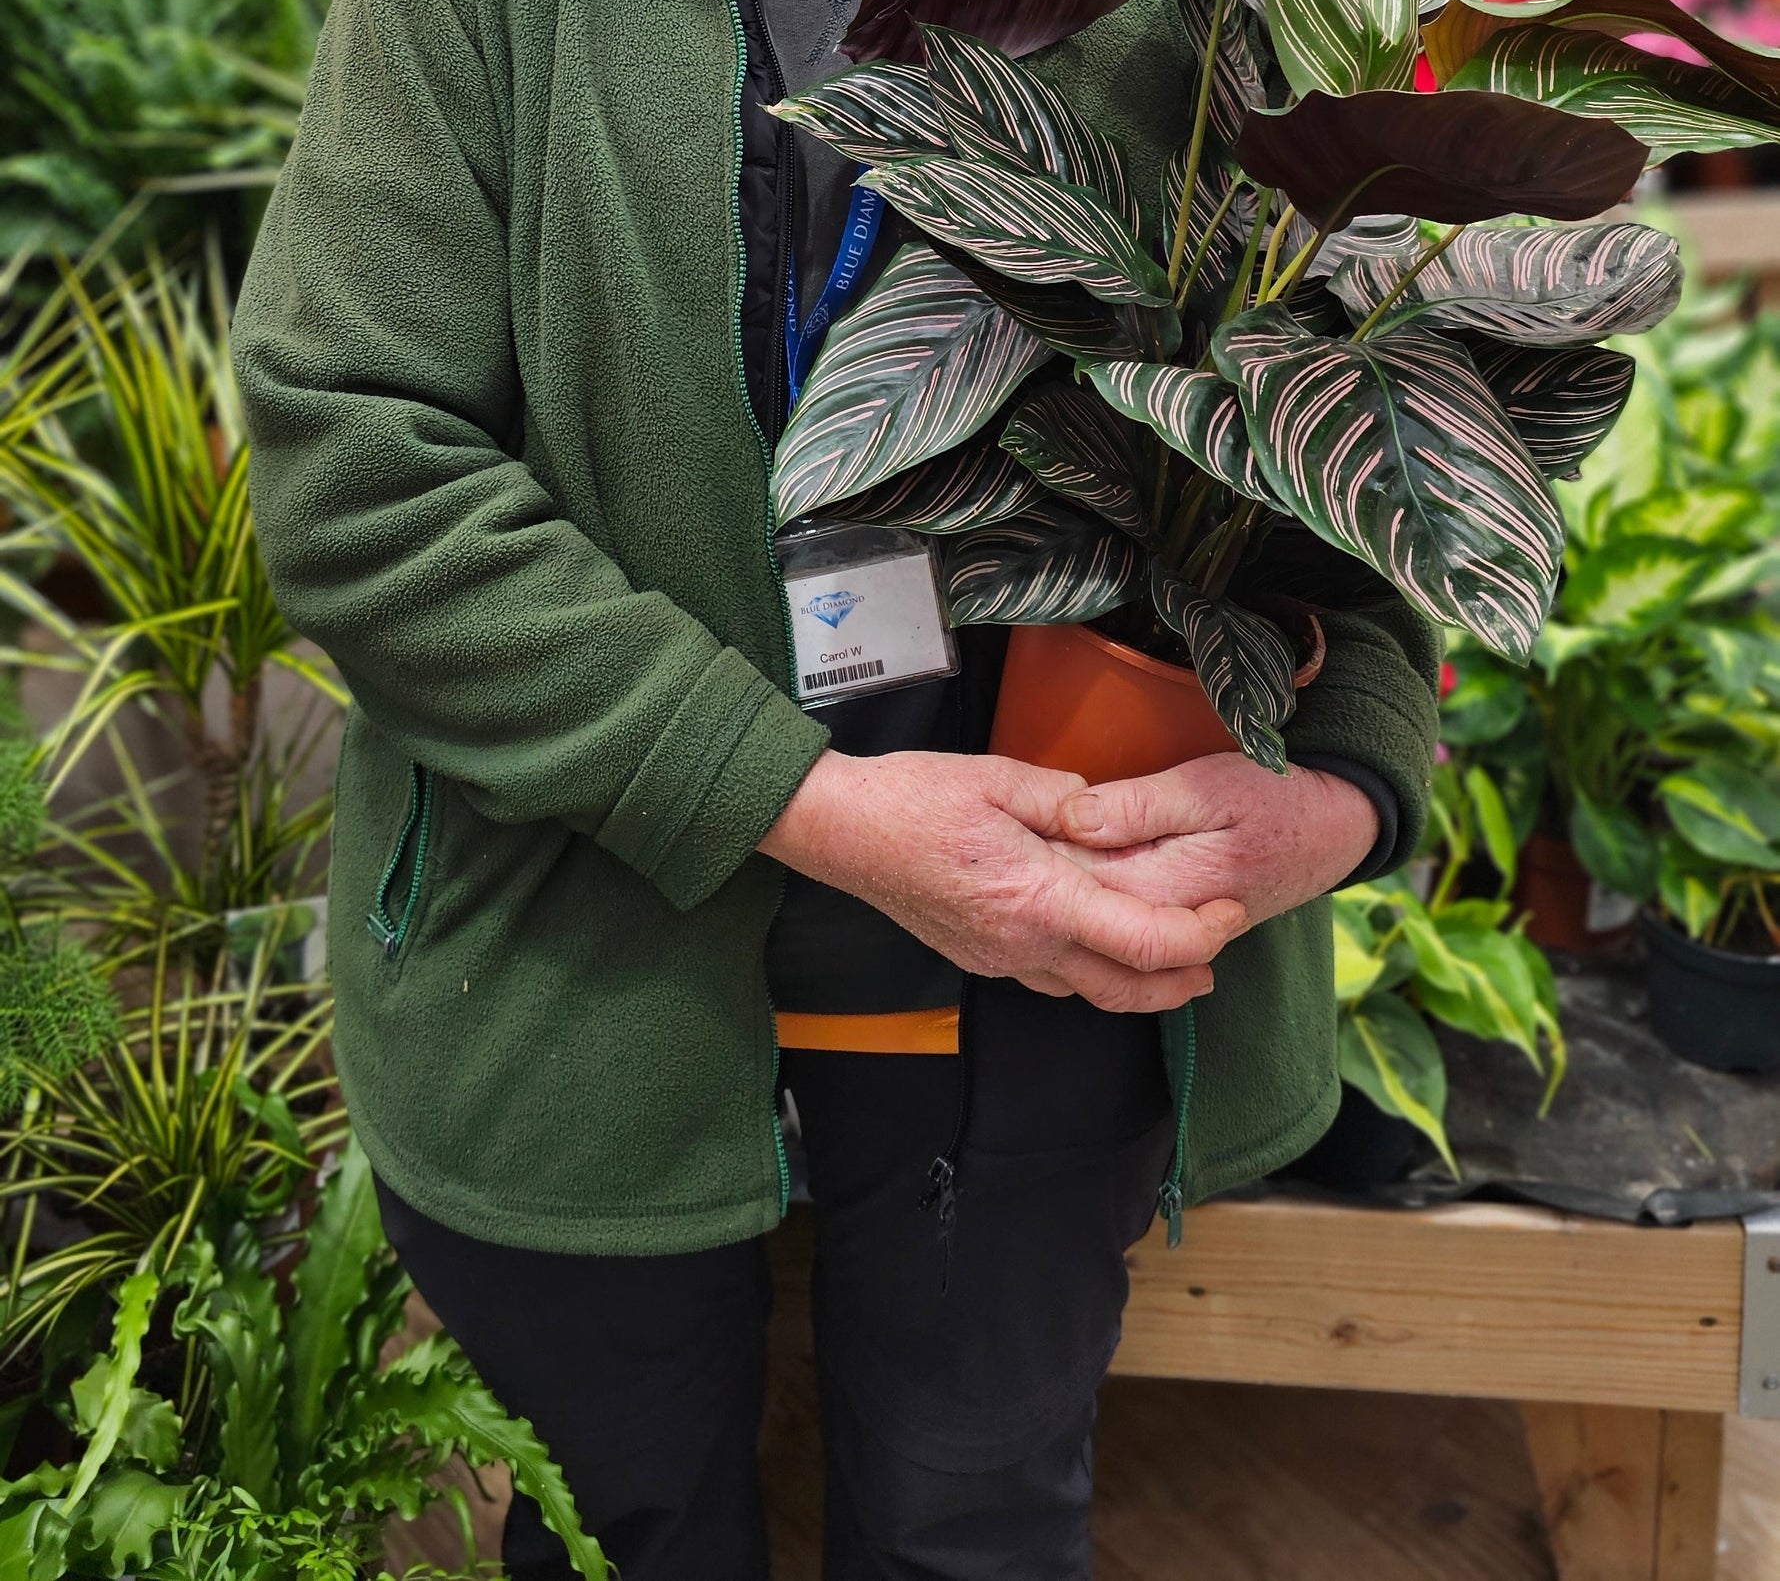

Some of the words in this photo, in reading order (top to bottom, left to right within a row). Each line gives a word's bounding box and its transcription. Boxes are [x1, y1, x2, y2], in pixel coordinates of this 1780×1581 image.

[836, 244, 864, 291] BLUE
[853, 189, 878, 240] DIAM
[822, 595, 865, 611] DIAMOND
[820, 649, 848, 664] Carol
[850, 645, 862, 657] W
